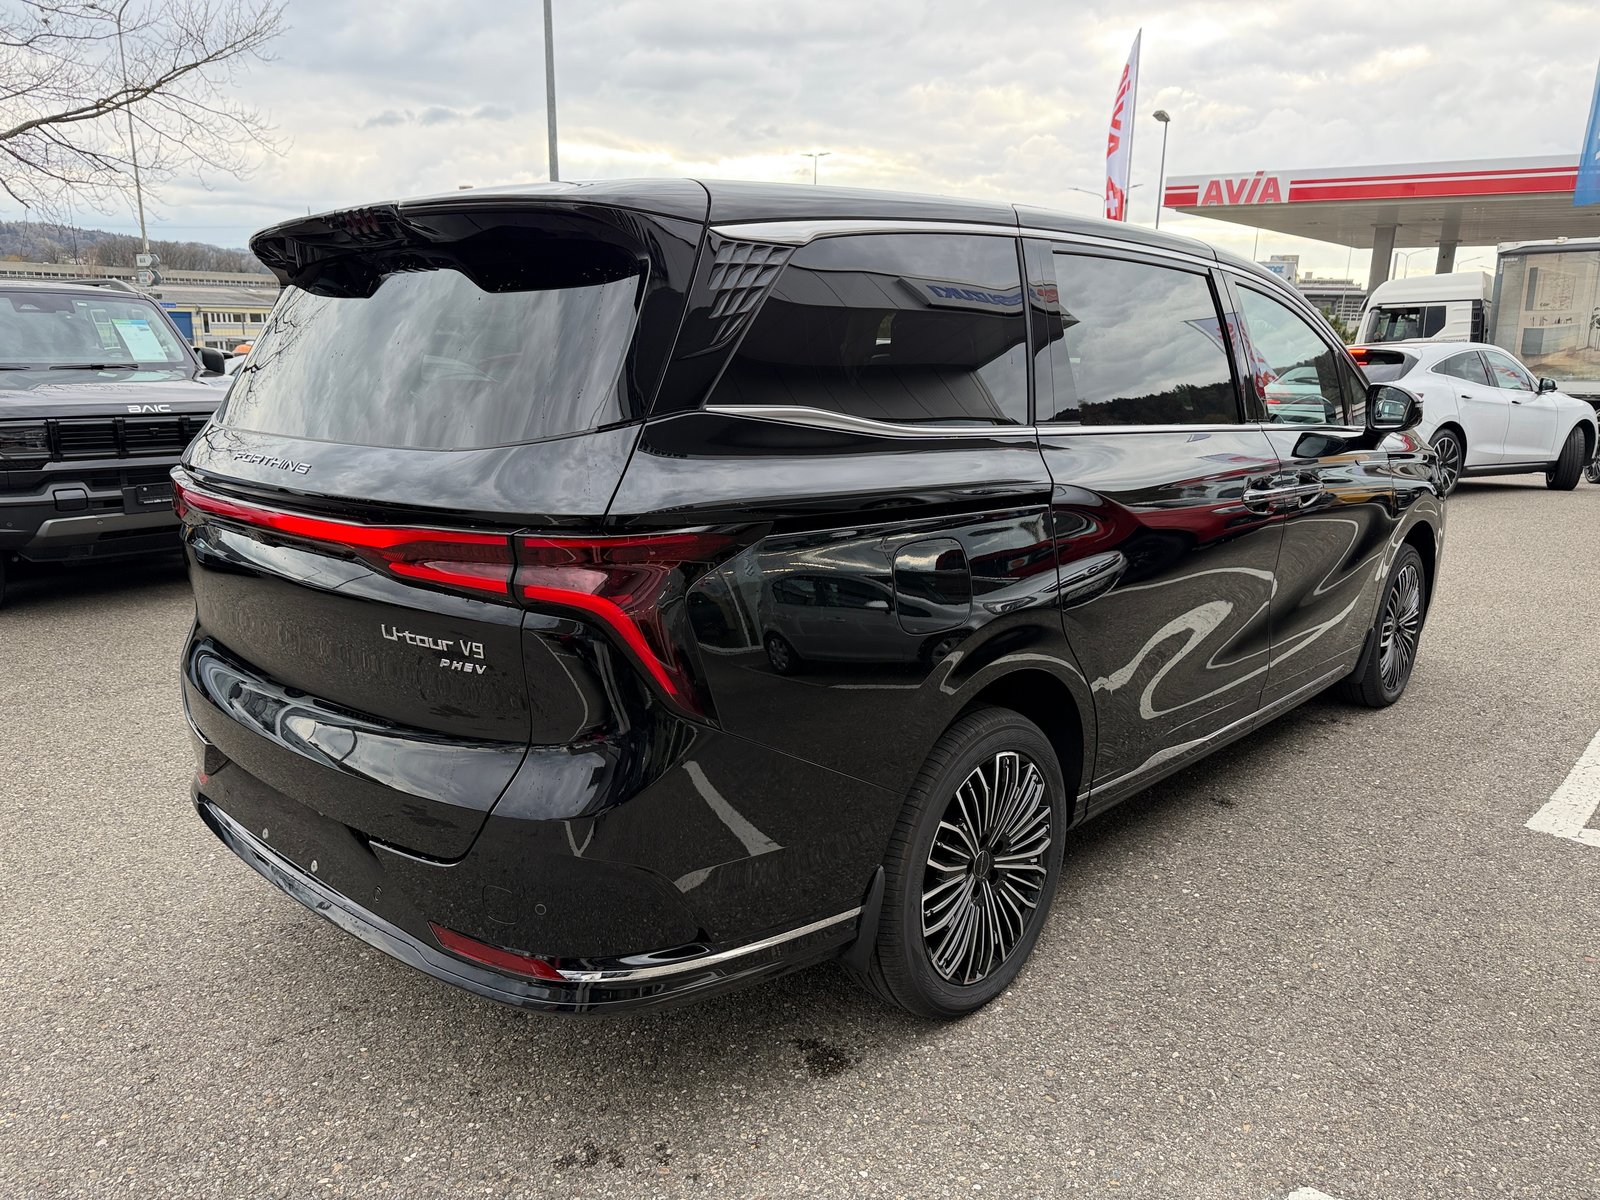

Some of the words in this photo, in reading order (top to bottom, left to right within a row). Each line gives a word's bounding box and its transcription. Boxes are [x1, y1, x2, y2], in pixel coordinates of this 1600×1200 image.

[1201, 170, 1282, 205] AVIA
[127, 404, 172, 413] BAIC
[233, 452, 312, 475] FORTHING
[459, 640, 485, 659] V9
[440, 658, 487, 675] PHEV
